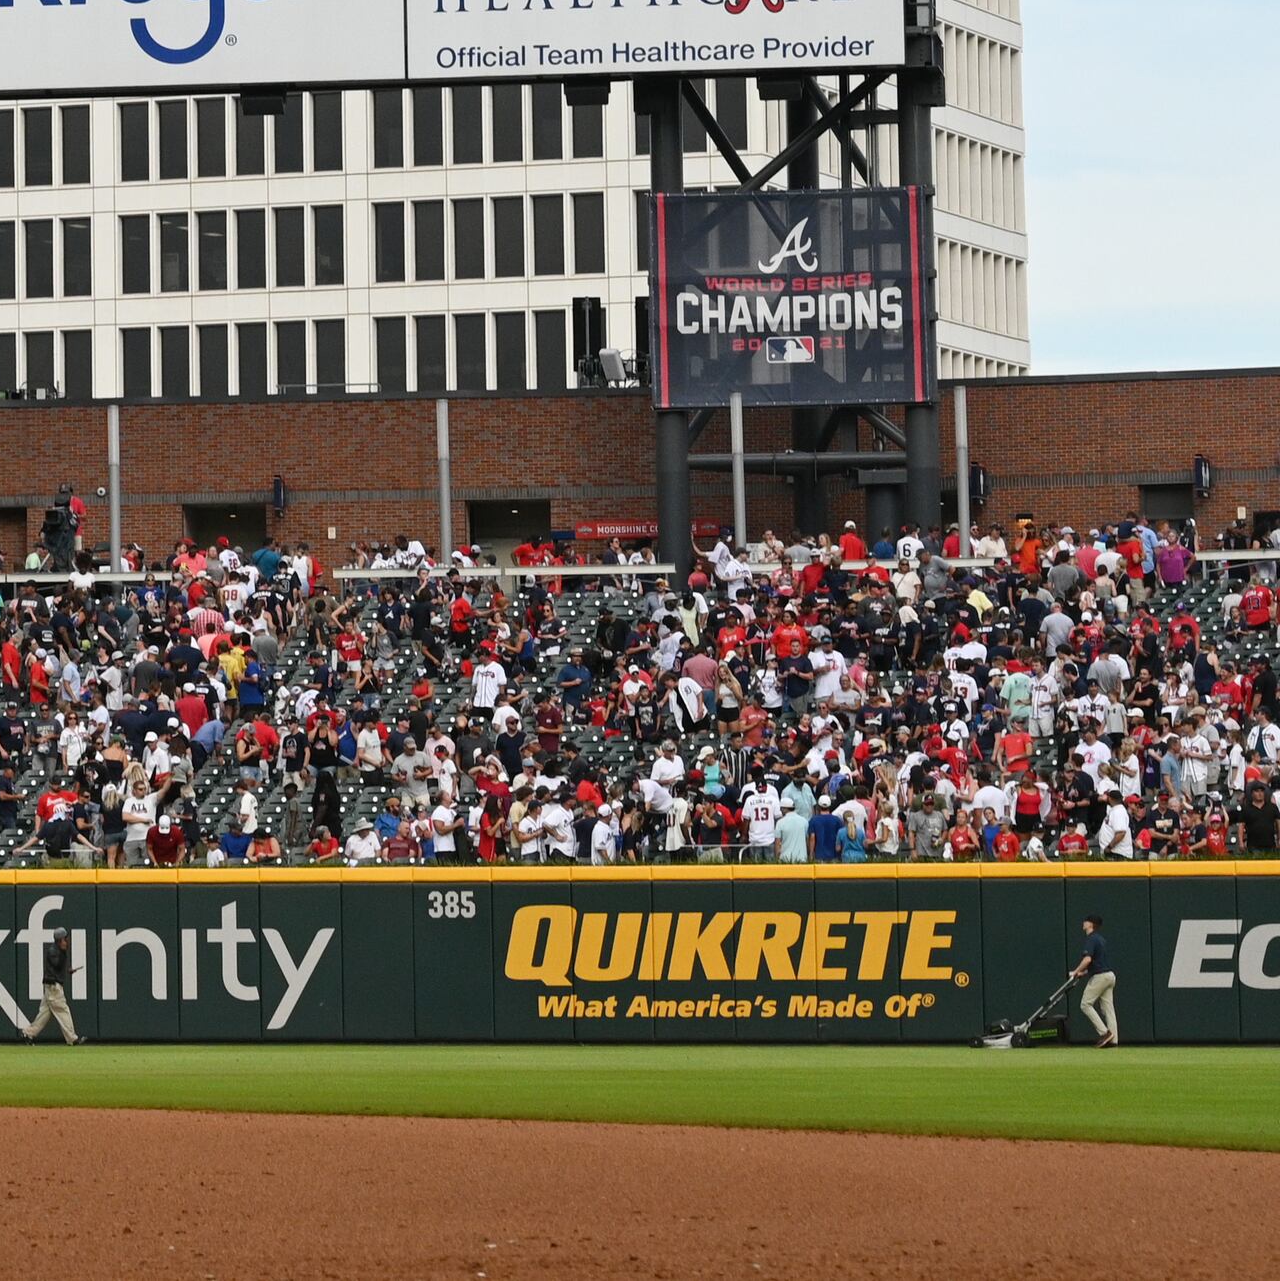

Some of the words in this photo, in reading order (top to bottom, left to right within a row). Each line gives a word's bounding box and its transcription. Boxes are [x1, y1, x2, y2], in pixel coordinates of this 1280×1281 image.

[436, 45, 527, 69] Official
[532, 42, 604, 67] Team
[611, 39, 756, 65] Healthcare
[763, 36, 876, 60] Provider
[705, 275, 786, 292] WORLD
[791, 272, 873, 292] SERIES
[676, 286, 903, 335] CHAMPIONS
[597, 525, 647, 534] MOONSHINE
[902, 543, 911, 558] 6
[1246, 597, 1261, 610] 13
[753, 807, 770, 821] 13
[427, 890, 477, 919] 385
[504, 904, 957, 986] QUIKRETE
[537, 995, 617, 1018] What
[626, 994, 778, 1018] America's
[787, 994, 874, 1018] Made
[884, 993, 922, 1018] Of
